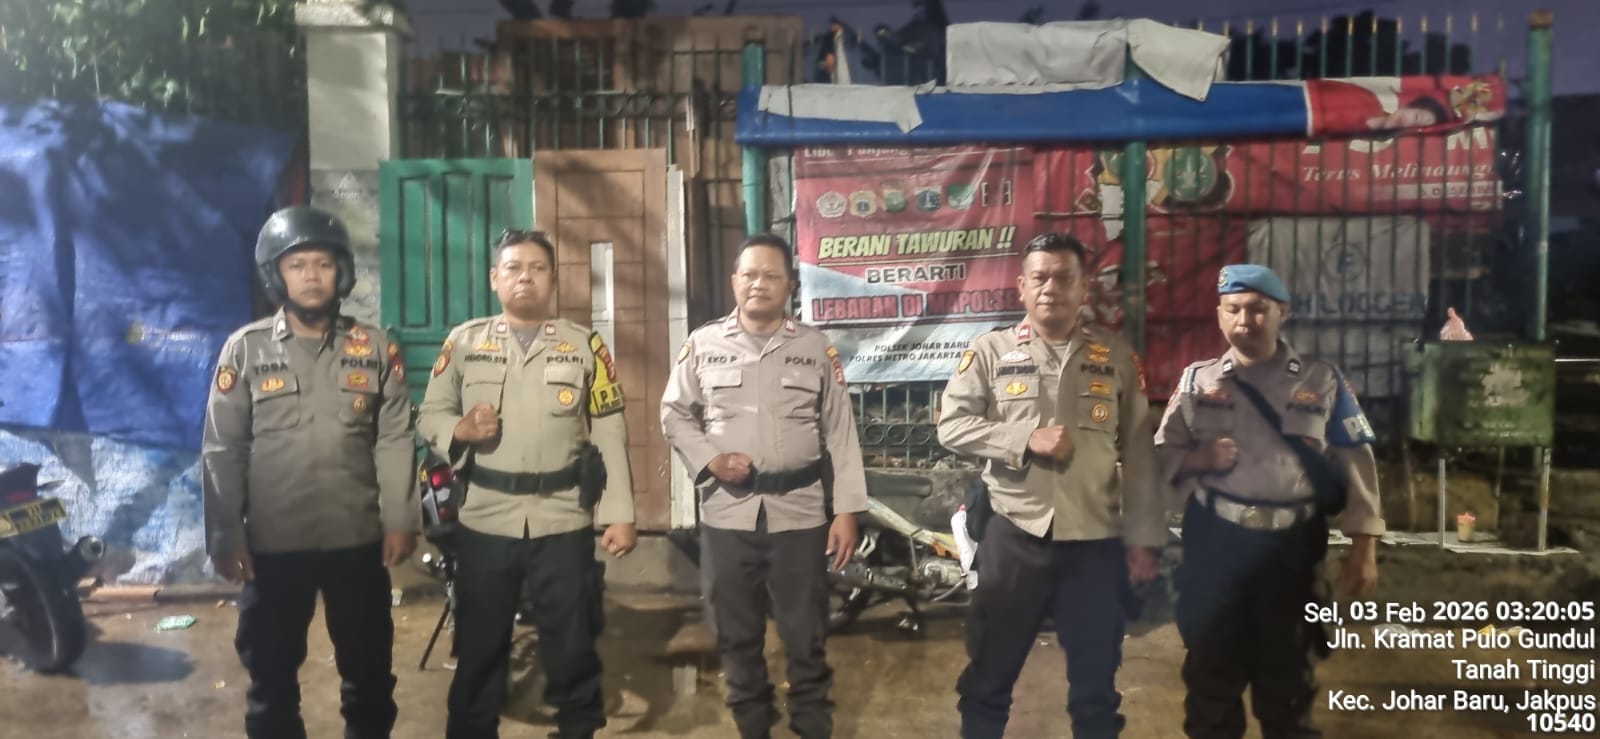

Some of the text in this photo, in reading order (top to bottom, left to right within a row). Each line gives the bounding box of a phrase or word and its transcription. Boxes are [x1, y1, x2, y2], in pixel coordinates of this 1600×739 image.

[819, 237, 890, 259] BERANI
[896, 228, 994, 255] TAWURAN
[867, 264, 965, 284] BERARTI
[812, 295, 898, 321] LEBARAN
[902, 294, 923, 318] DI
[874, 341, 970, 353] POLSEK JOHAR BARU
[546, 354, 583, 365] POLRI
[707, 356, 727, 364] EKO
[784, 356, 817, 367] POLRI
[849, 351, 961, 363] POLRES METRO JAKARTA
[340, 358, 379, 369] POLRI
